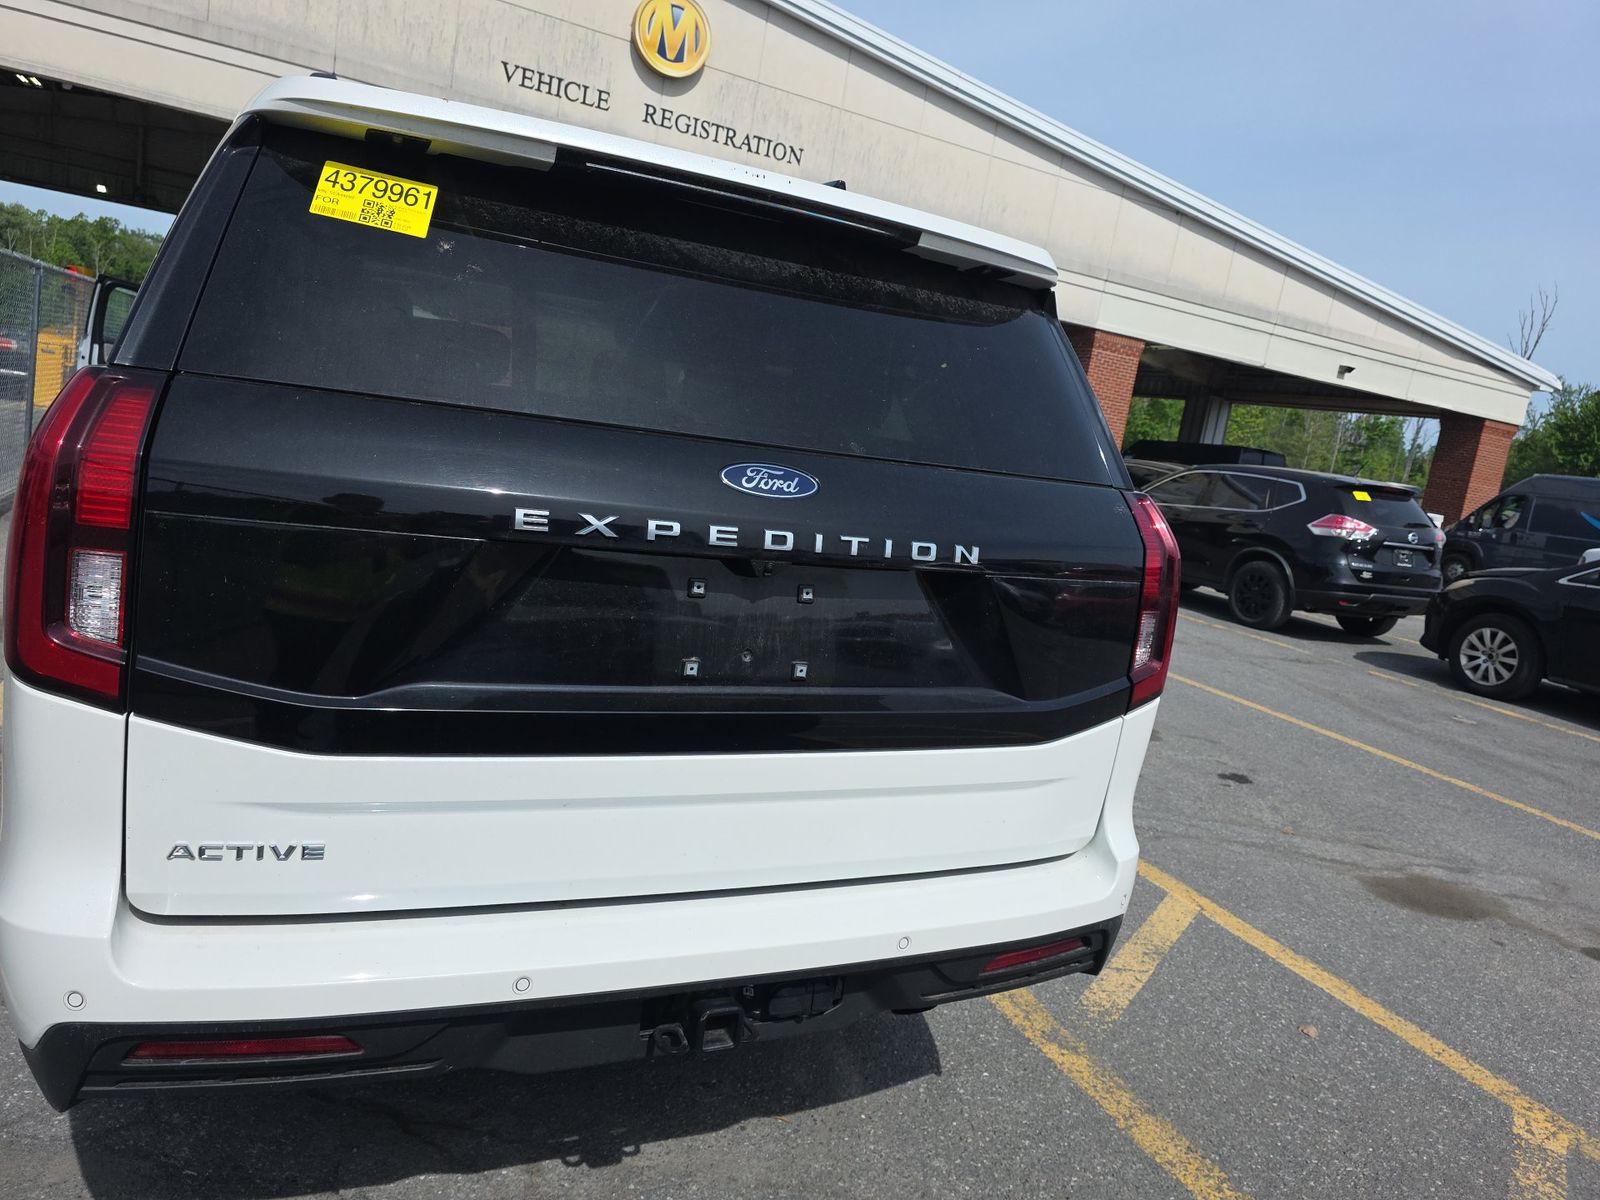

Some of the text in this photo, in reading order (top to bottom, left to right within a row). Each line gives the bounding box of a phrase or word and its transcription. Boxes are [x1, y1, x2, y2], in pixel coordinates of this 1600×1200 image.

[501, 60, 804, 166] VEHICLE REGISTRATION
[315, 194, 340, 206] FOR
[324, 169, 432, 210] 4379961
[741, 466, 800, 494] Ford
[514, 507, 980, 565] EXPEDITION
[166, 840, 325, 861] ACTIVE
